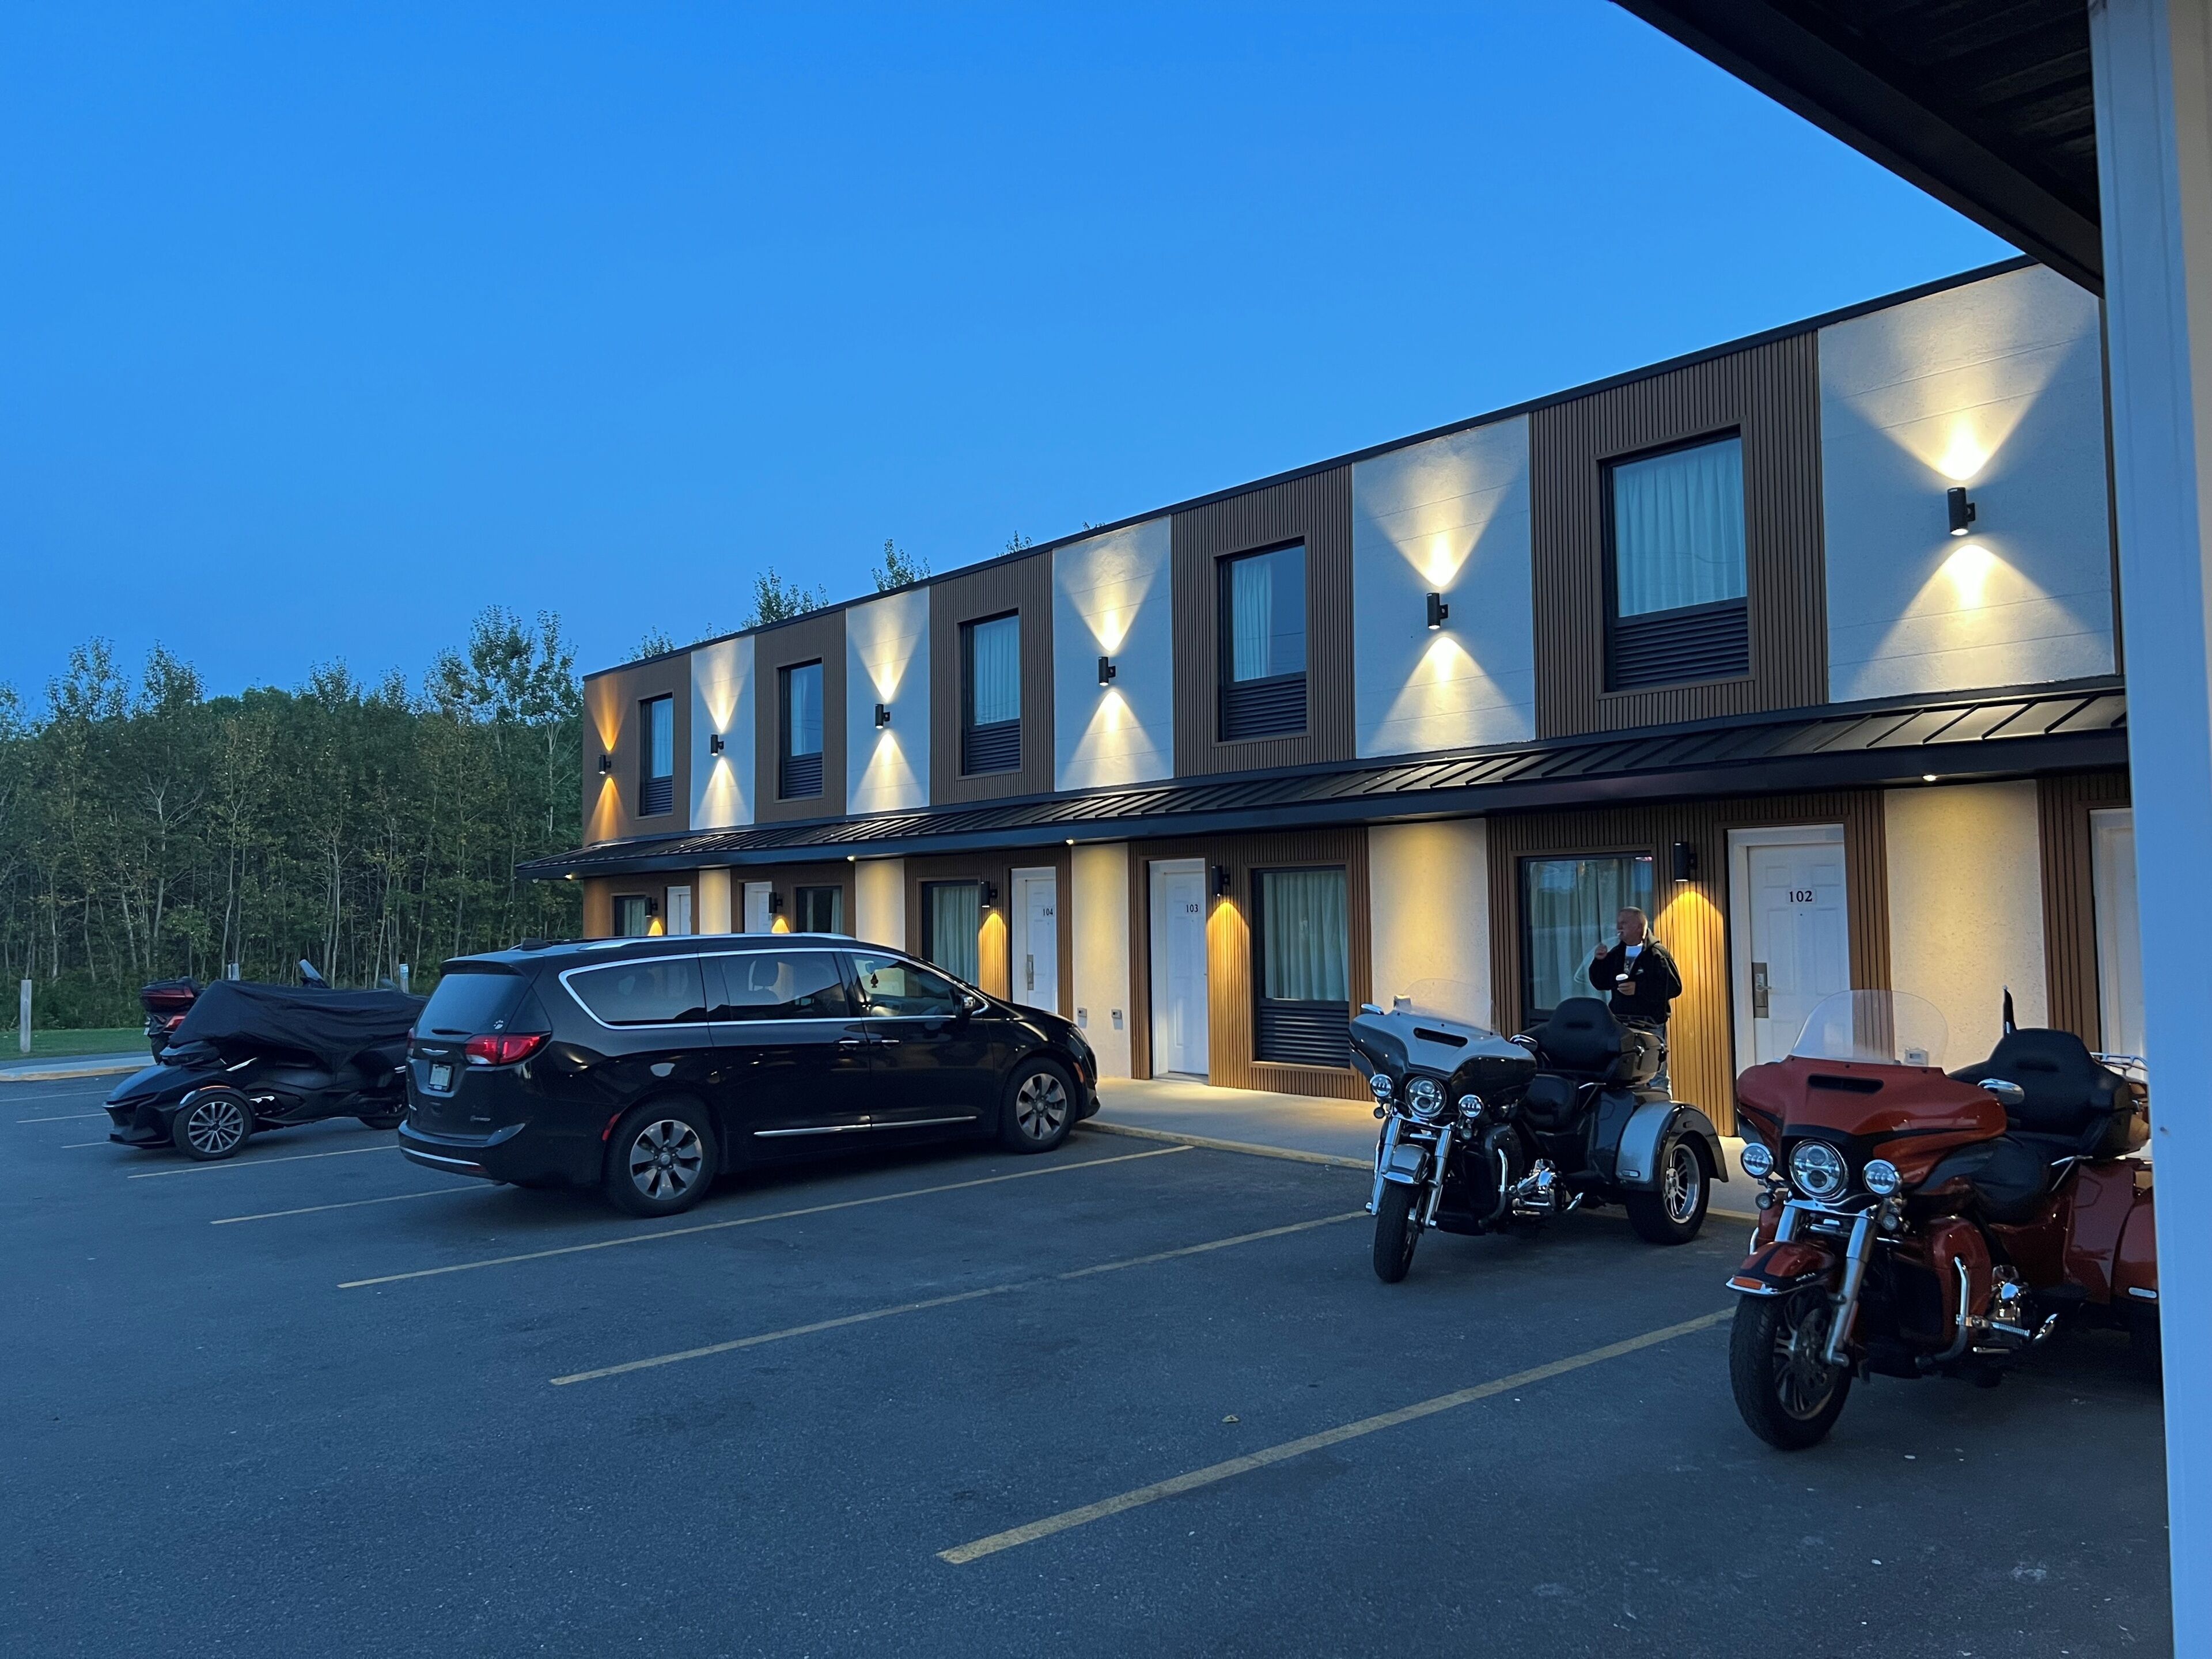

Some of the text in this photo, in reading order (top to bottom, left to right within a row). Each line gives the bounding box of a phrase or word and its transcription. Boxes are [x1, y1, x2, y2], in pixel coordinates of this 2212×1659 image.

[1789, 891, 1813, 903] 102
[1043, 908, 1053, 916] 104
[1186, 904, 1198, 913] 103
